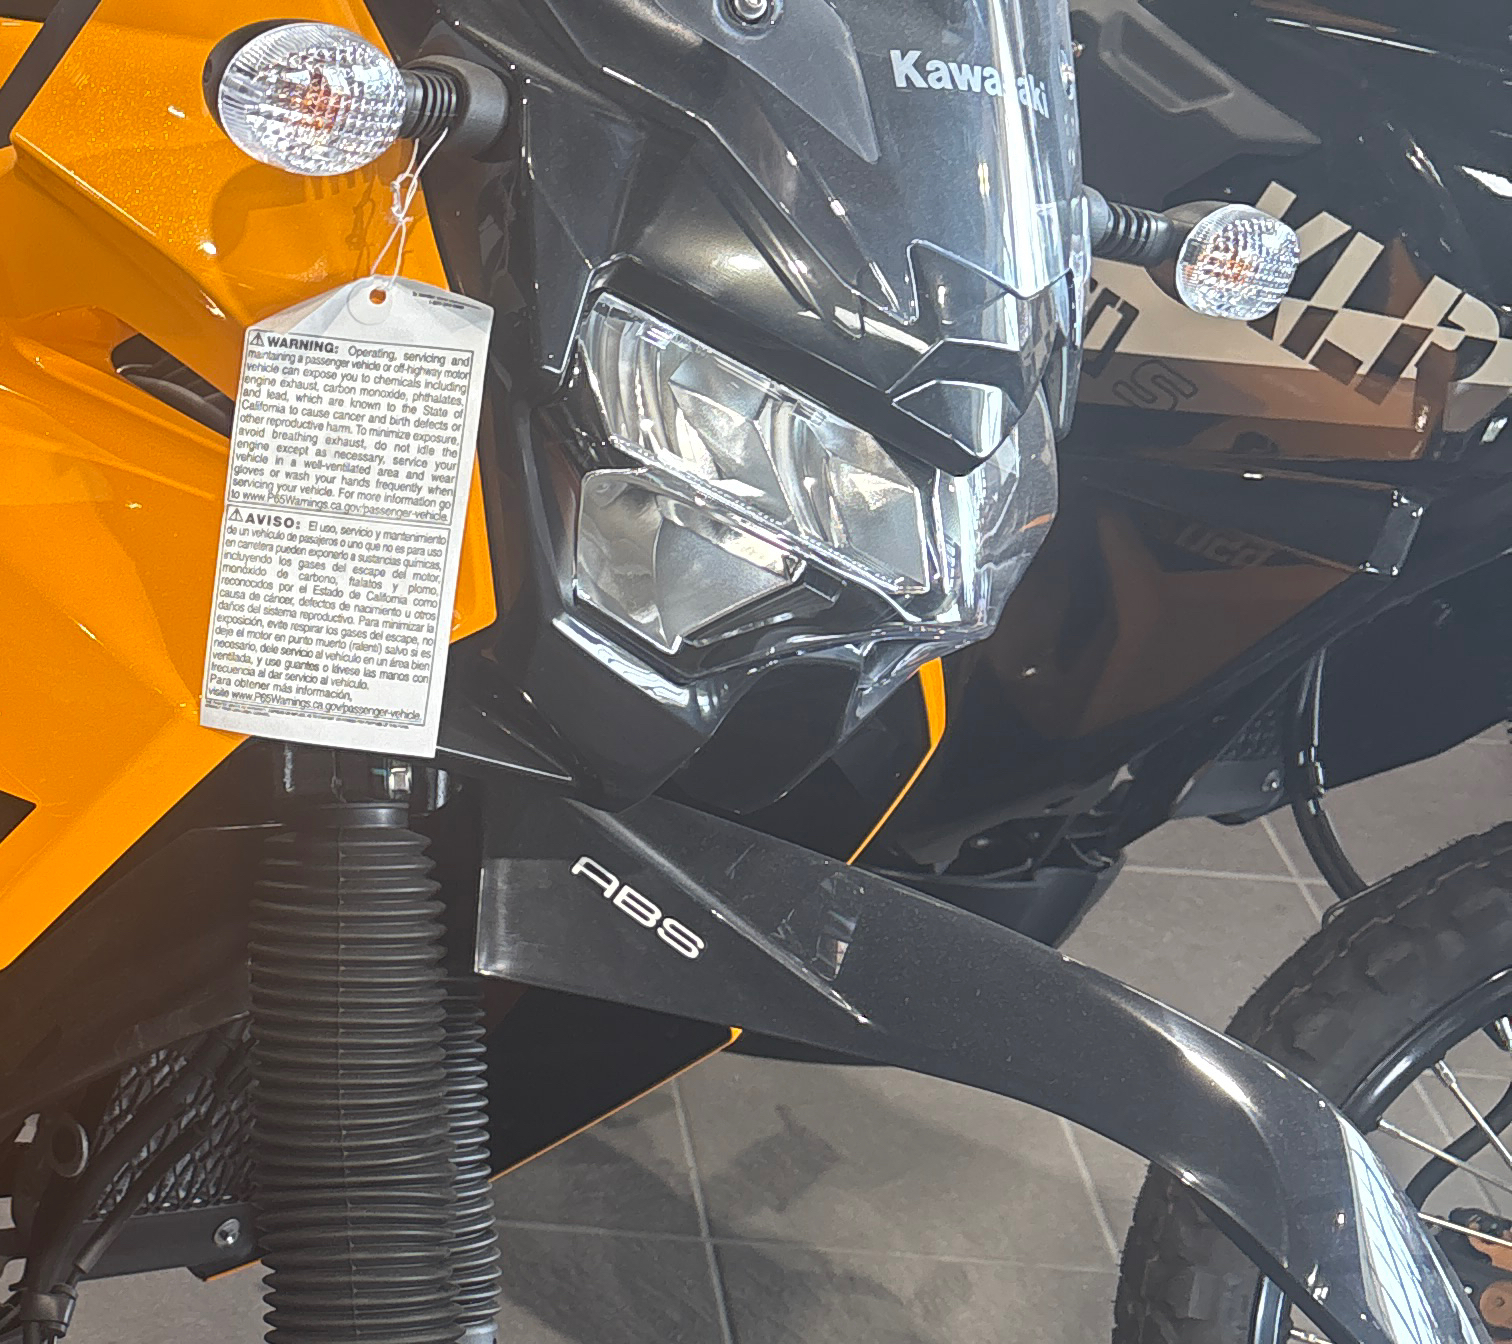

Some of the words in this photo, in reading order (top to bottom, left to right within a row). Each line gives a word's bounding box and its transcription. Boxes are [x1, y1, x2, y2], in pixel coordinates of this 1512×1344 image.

[890, 49, 1049, 119] Kawaaki
[246, 348, 296, 364] maintaining
[304, 355, 349, 370] passenger
[351, 358, 381, 371] vehicle
[392, 362, 442, 379] off-highway
[443, 367, 468, 379] motor
[266, 336, 339, 354] WARNING:
[403, 351, 446, 367] servicing
[450, 355, 469, 366] and
[243, 373, 276, 388] engine
[322, 381, 356, 394] carbon
[244, 361, 279, 374] vehicle
[281, 366, 299, 376] can
[302, 368, 337, 382] expose
[340, 372, 358, 384] you
[373, 374, 421, 388] chemicals
[423, 379, 467, 395] including
[241, 400, 286, 413] California
[300, 407, 330, 418] cause
[332, 411, 365, 422] cancer
[367, 412, 386, 424] and
[389, 415, 411, 426] birth
[413, 417, 448, 430] defects
[242, 386, 261, 398] and
[295, 392, 323, 404] which
[328, 397, 344, 406] are
[349, 397, 381, 410] known
[401, 403, 417, 414] the
[422, 405, 448, 417] State
[238, 426, 265, 438] avoid
[271, 429, 318, 446] breathing
[393, 442, 410, 453] not
[416, 444, 435, 455] idle
[441, 447, 457, 458] the
[239, 413, 264, 425] other
[265, 415, 324, 433] reproductive
[368, 426, 411, 440] minimize
[235, 451, 268, 463] vehicle
[303, 458, 371, 474] well-ventilated
[376, 467, 399, 477] area
[405, 469, 425, 480] and
[430, 473, 455, 483] wear
[236, 438, 269, 453] engine
[275, 442, 309, 457] except
[392, 454, 428, 467] service
[434, 460, 456, 473] your
[231, 476, 274, 492] servicing
[276, 482, 297, 494] your
[337, 487, 354, 498] For
[356, 491, 381, 501] more
[383, 492, 436, 507] information
[233, 463, 264, 478] gloves
[284, 469, 310, 481] wash
[314, 474, 336, 486] your
[340, 475, 370, 487] hands
[374, 478, 423, 495] frequently
[427, 484, 453, 496] when
[244, 512, 301, 529] AVISO:
[571, 856, 706, 959] ABS
